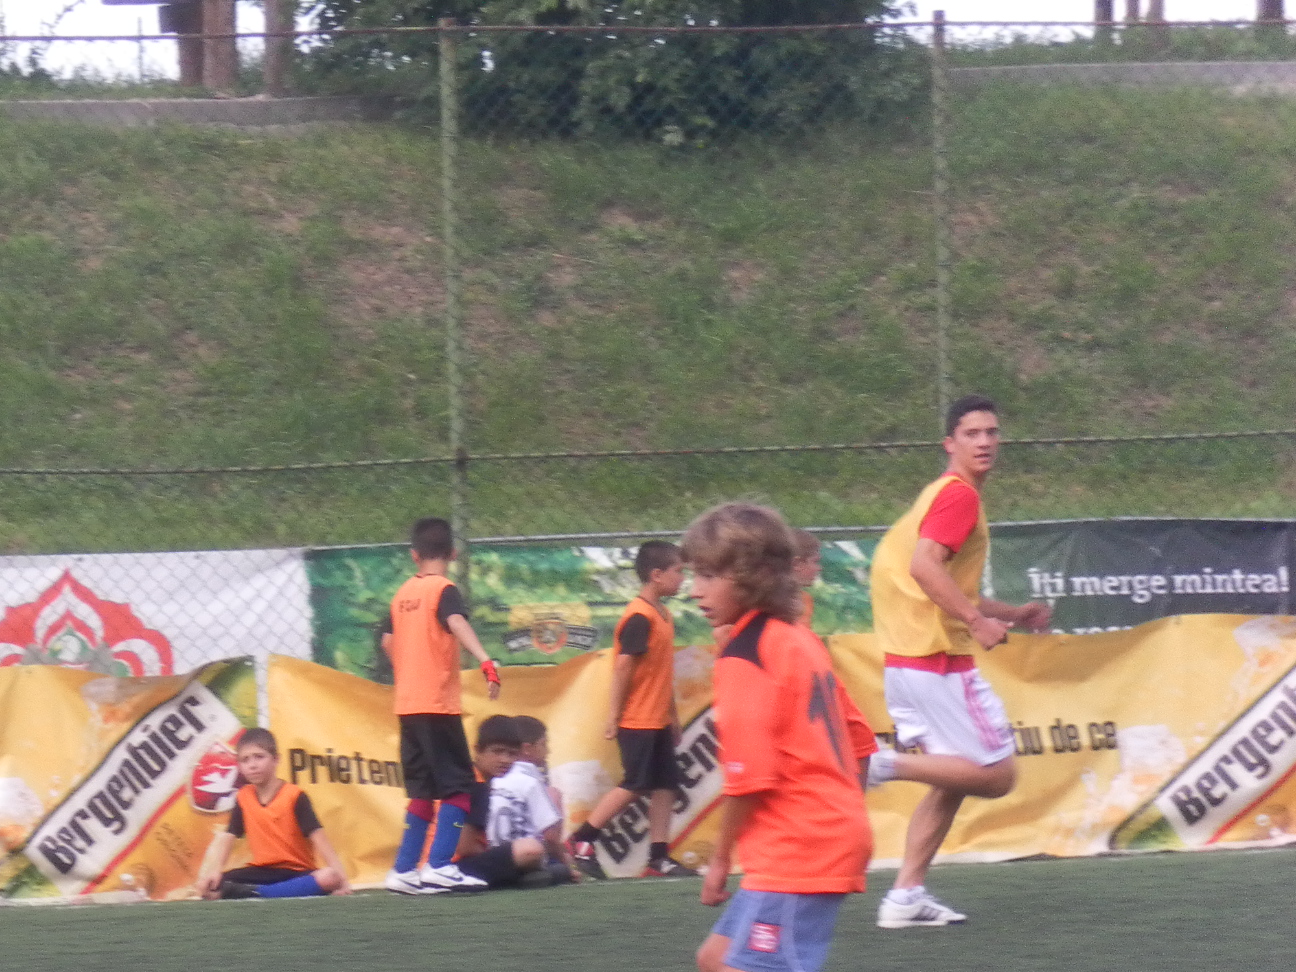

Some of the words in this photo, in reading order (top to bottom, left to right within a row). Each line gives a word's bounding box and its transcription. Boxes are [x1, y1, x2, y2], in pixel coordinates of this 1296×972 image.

[1069, 575, 1167, 603] merge
[1172, 566, 1290, 594] mintea!
[1050, 718, 1081, 754] de
[1088, 720, 1117, 751] ce
[1170, 684, 1296, 826] Bergen
[38, 696, 206, 875] Bergenbier
[289, 747, 404, 788] Prieten
